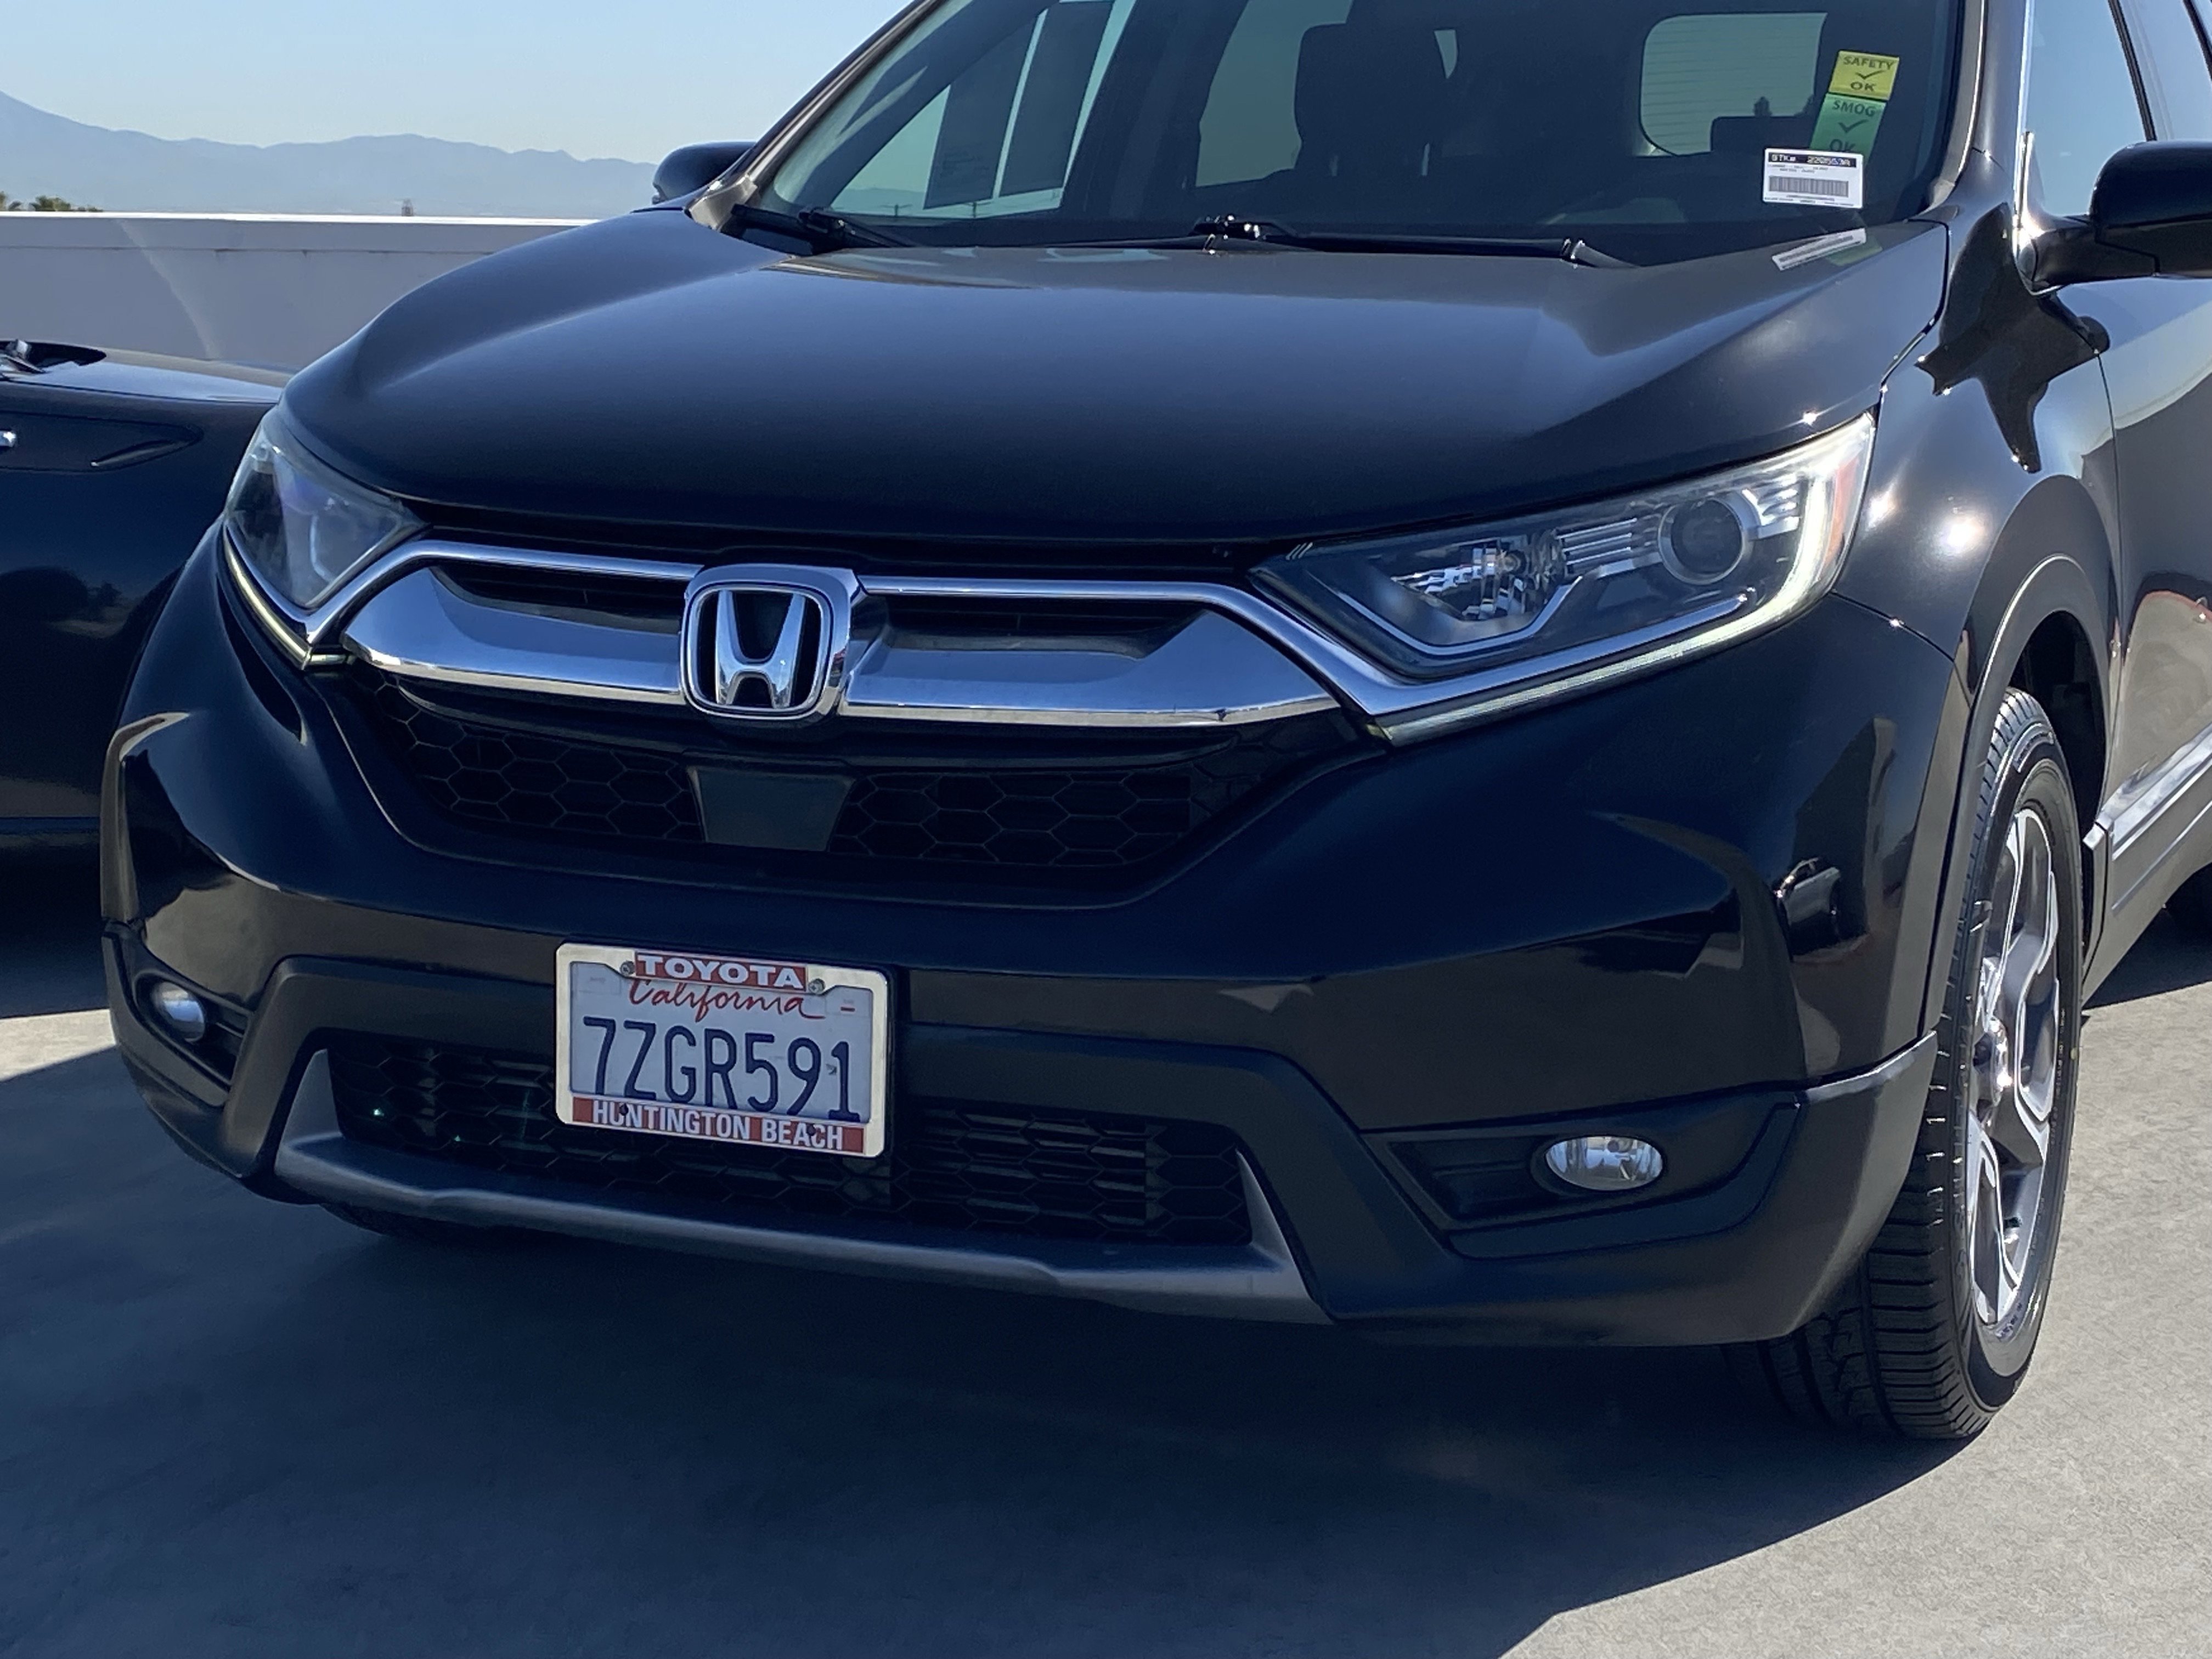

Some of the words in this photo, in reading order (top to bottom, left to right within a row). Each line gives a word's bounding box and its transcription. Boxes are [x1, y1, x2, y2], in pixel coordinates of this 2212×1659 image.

[1843, 55, 1897, 70] SAFETY
[1850, 82, 1876, 92] OK
[1833, 99, 1876, 117] SMOG
[636, 954, 805, 990] TOYOTA
[628, 978, 826, 1023] California
[583, 1016, 861, 1122] 7ZGR591
[592, 1097, 751, 1141] HUNTINGTON
[761, 1119, 844, 1150] BEACH
